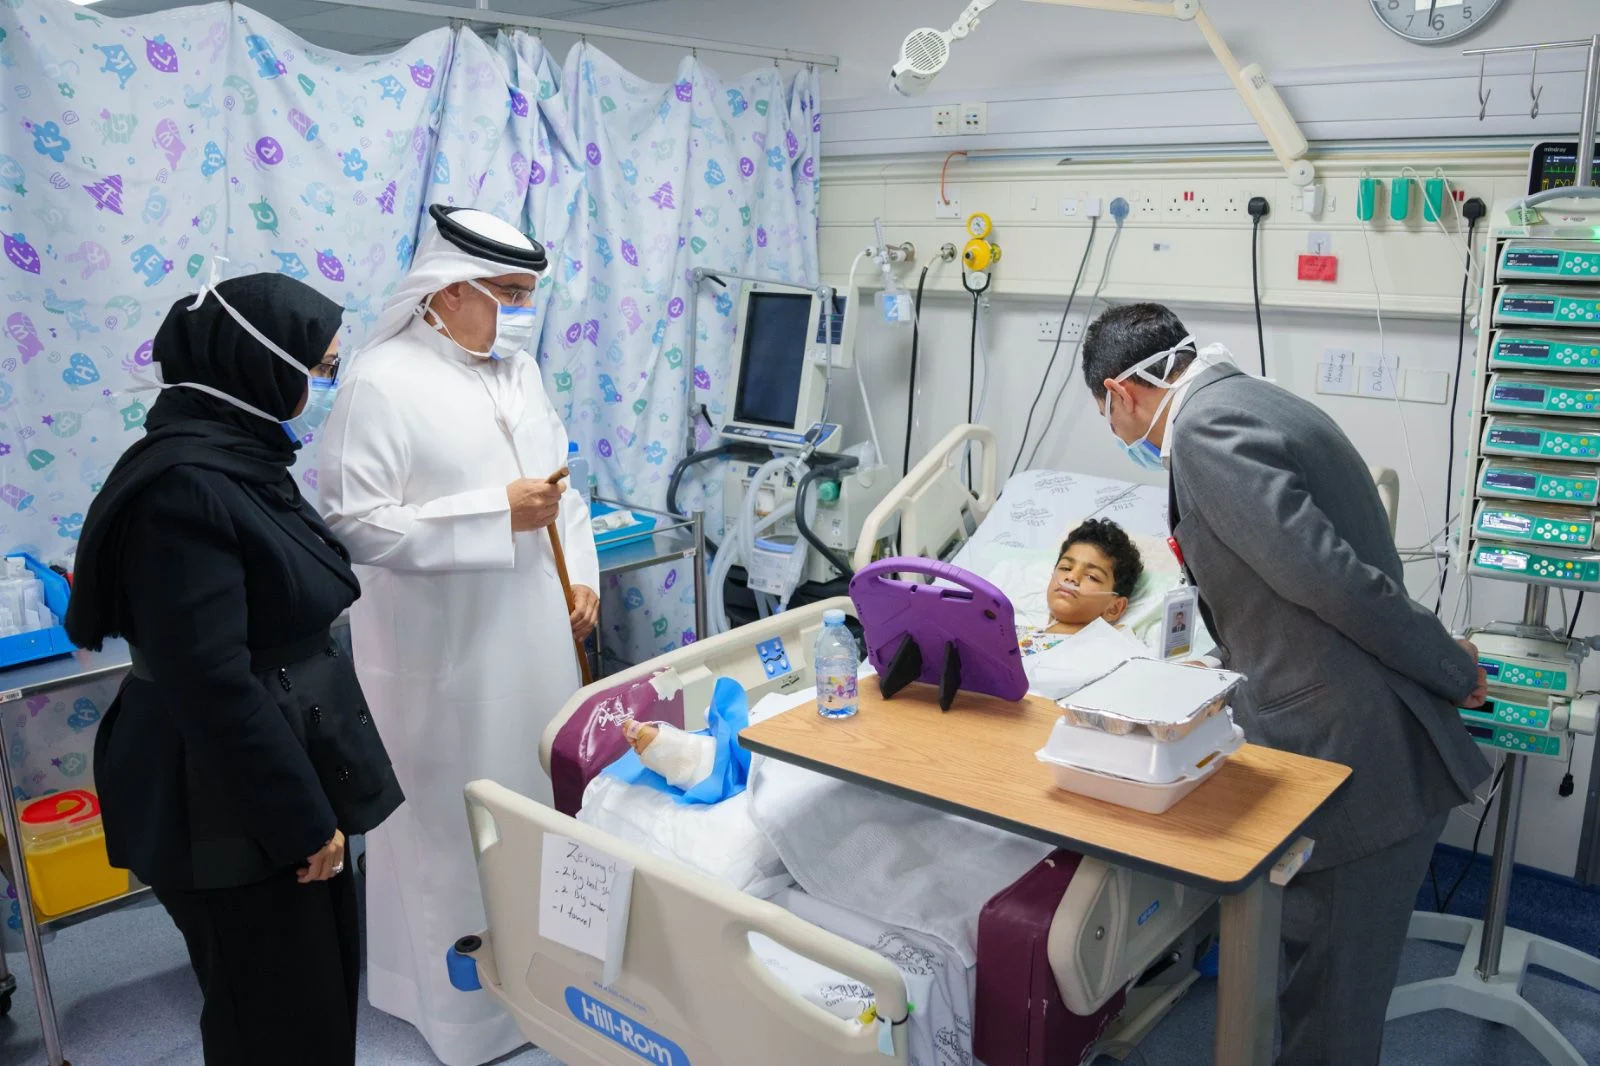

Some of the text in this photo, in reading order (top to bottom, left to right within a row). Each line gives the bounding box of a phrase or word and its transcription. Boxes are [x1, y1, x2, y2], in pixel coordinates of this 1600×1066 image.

[1462, 6, 1473, 20] 5
[1404, 14, 1415, 31] 7
[1431, 13, 1445, 31] 6
[581, 995, 674, 1066] Hill-Rom
